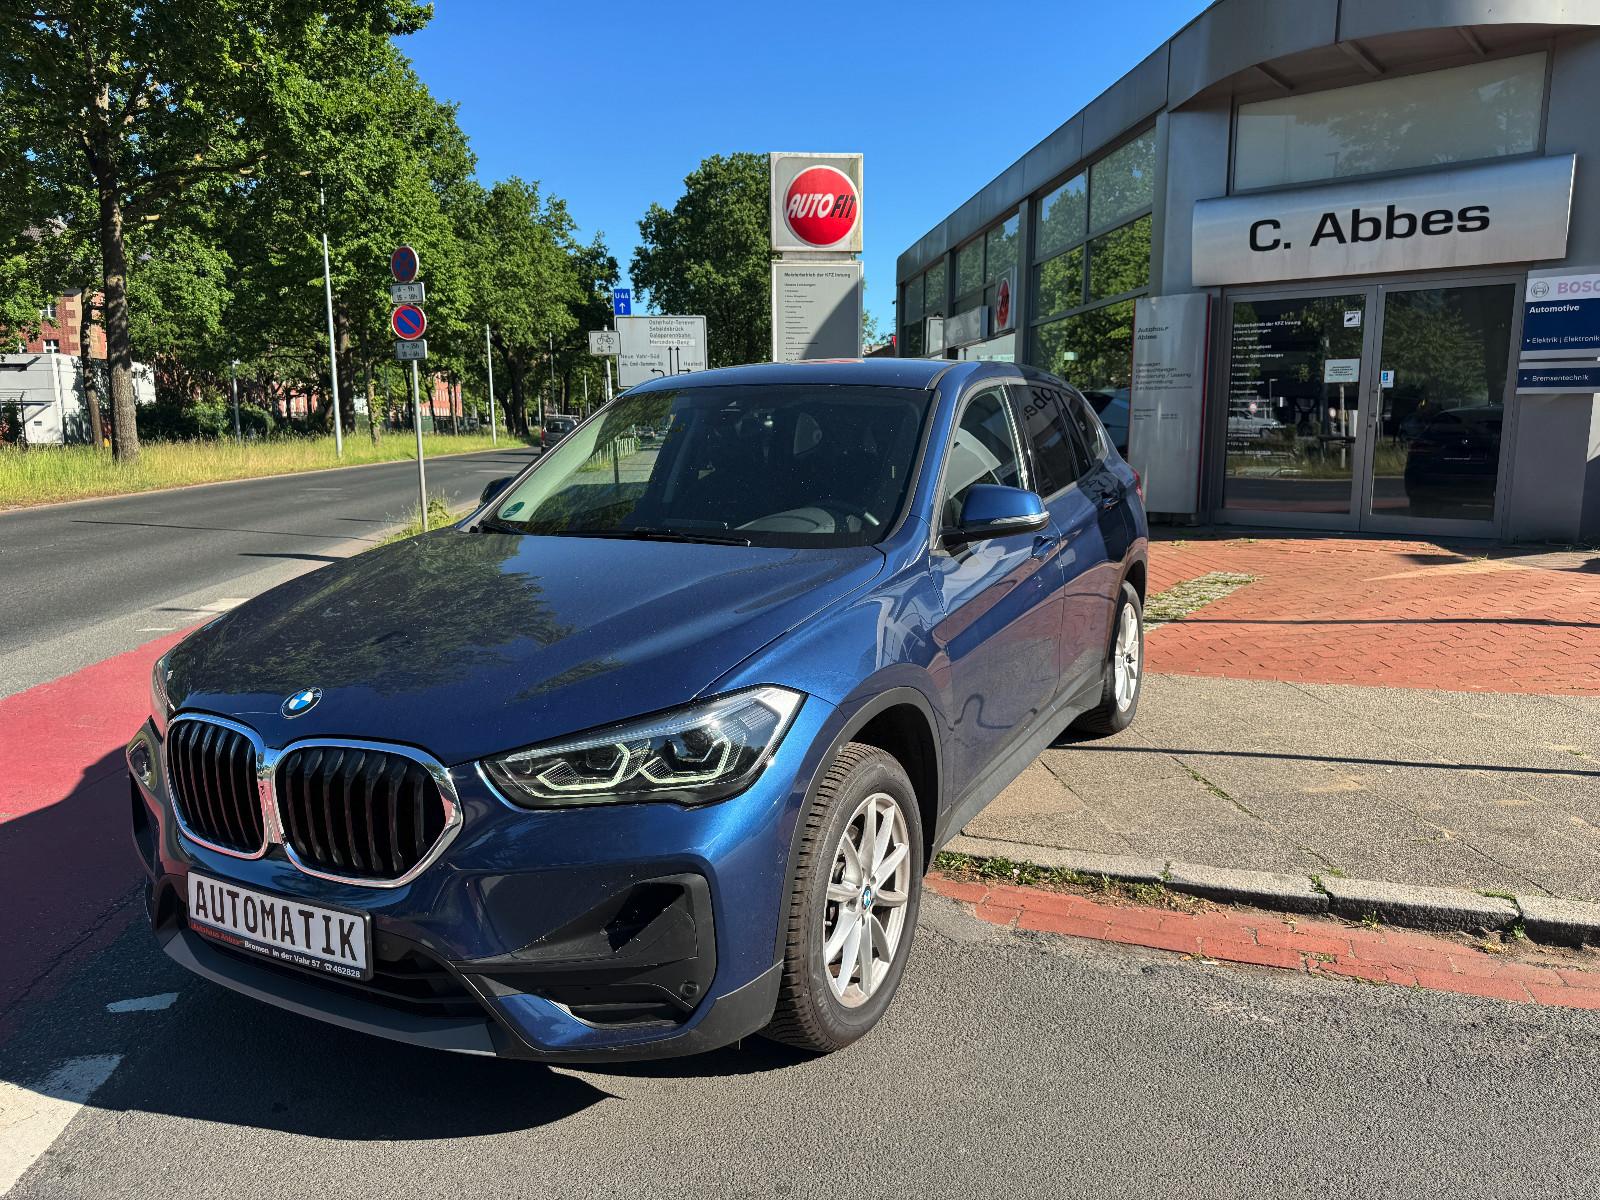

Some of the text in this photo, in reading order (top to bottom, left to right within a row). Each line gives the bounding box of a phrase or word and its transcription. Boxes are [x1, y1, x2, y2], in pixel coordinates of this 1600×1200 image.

[787, 193, 857, 218] AUTOFIT
[1249, 204, 1490, 252] C. Abbes
[1529, 304, 1580, 314] Automotive
[1532, 336, 1558, 344] Elektrik
[1563, 335, 1600, 343] Elektronik
[1532, 374, 1589, 382] Bremsentechnik
[195, 880, 357, 962] AUTOMATIK
[280, 951, 293, 960] der
[293, 954, 310, 965] Vahr
[311, 960, 321, 968] 57
[332, 965, 361, 978] 462828
